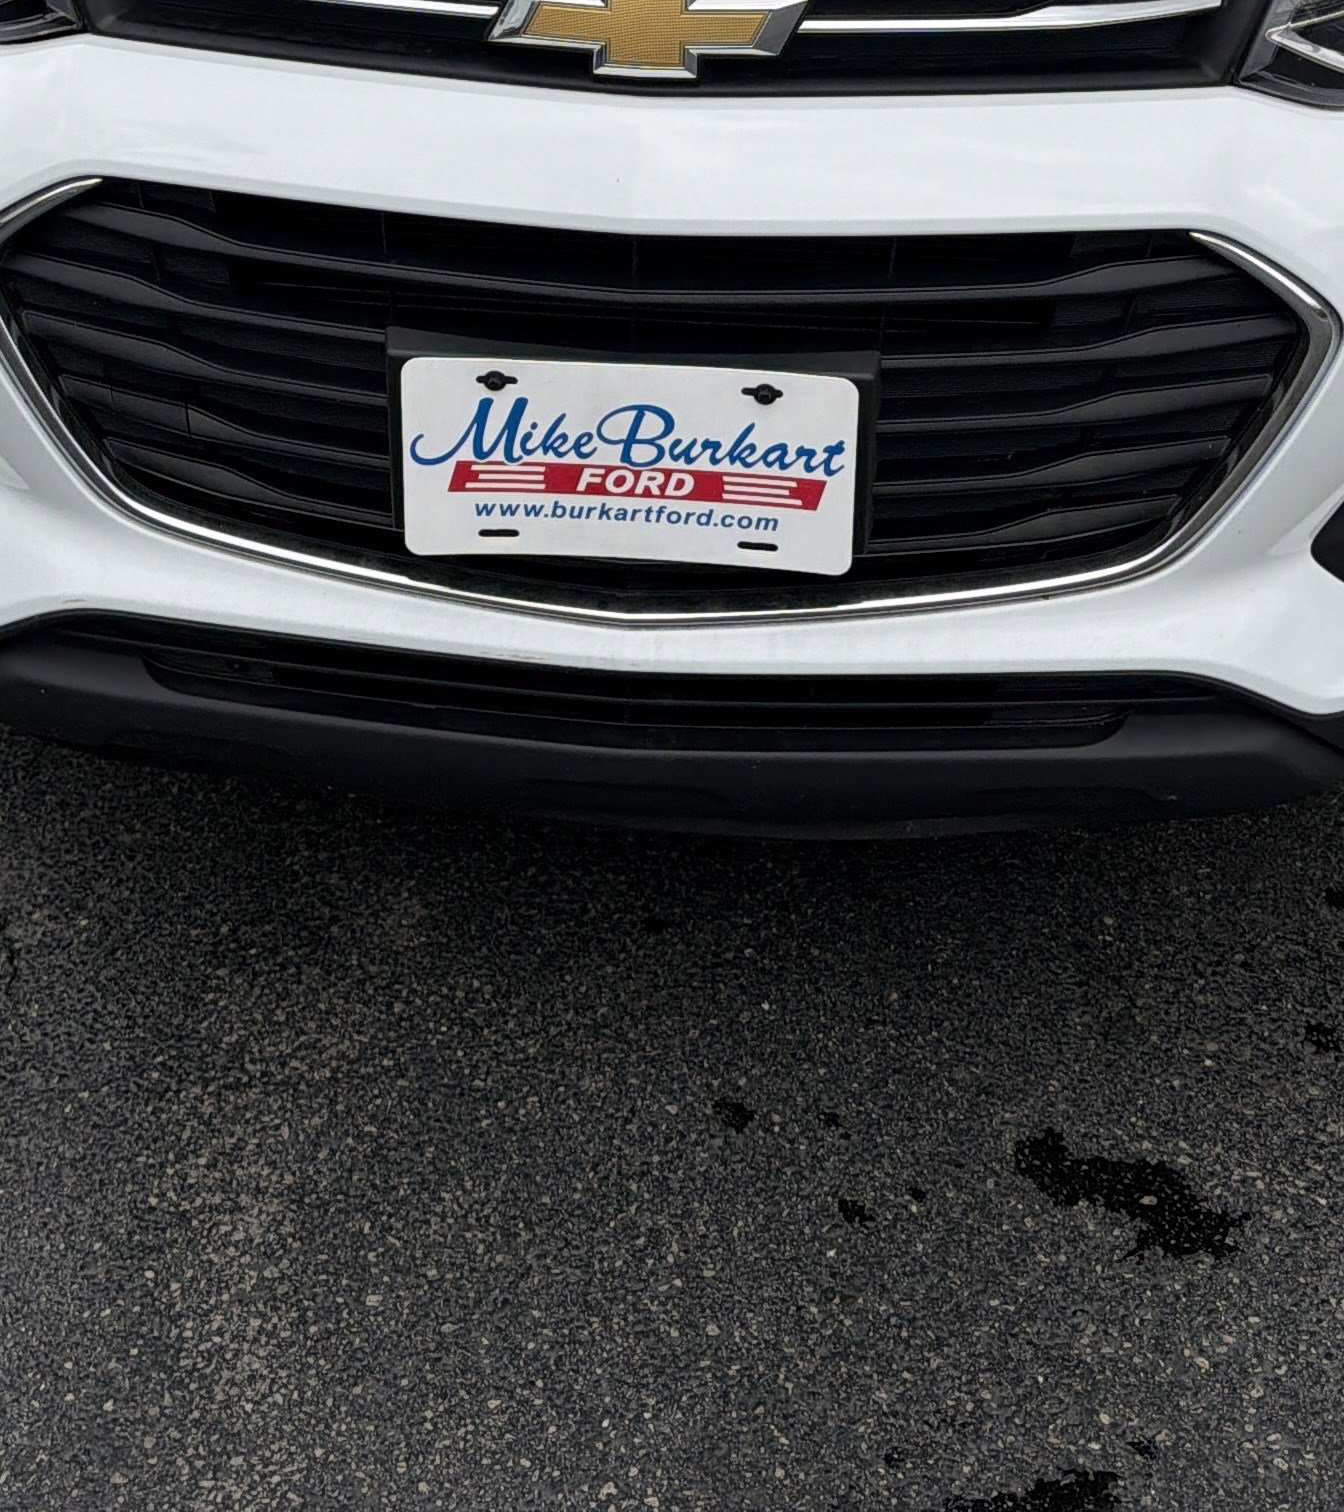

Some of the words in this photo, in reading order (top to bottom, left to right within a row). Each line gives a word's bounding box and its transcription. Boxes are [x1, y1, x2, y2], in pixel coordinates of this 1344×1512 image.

[410, 397, 597, 465] Mike
[597, 404, 845, 477] Burkart
[575, 467, 695, 498] FORD
[474, 500, 779, 532] www.burkartford.com
